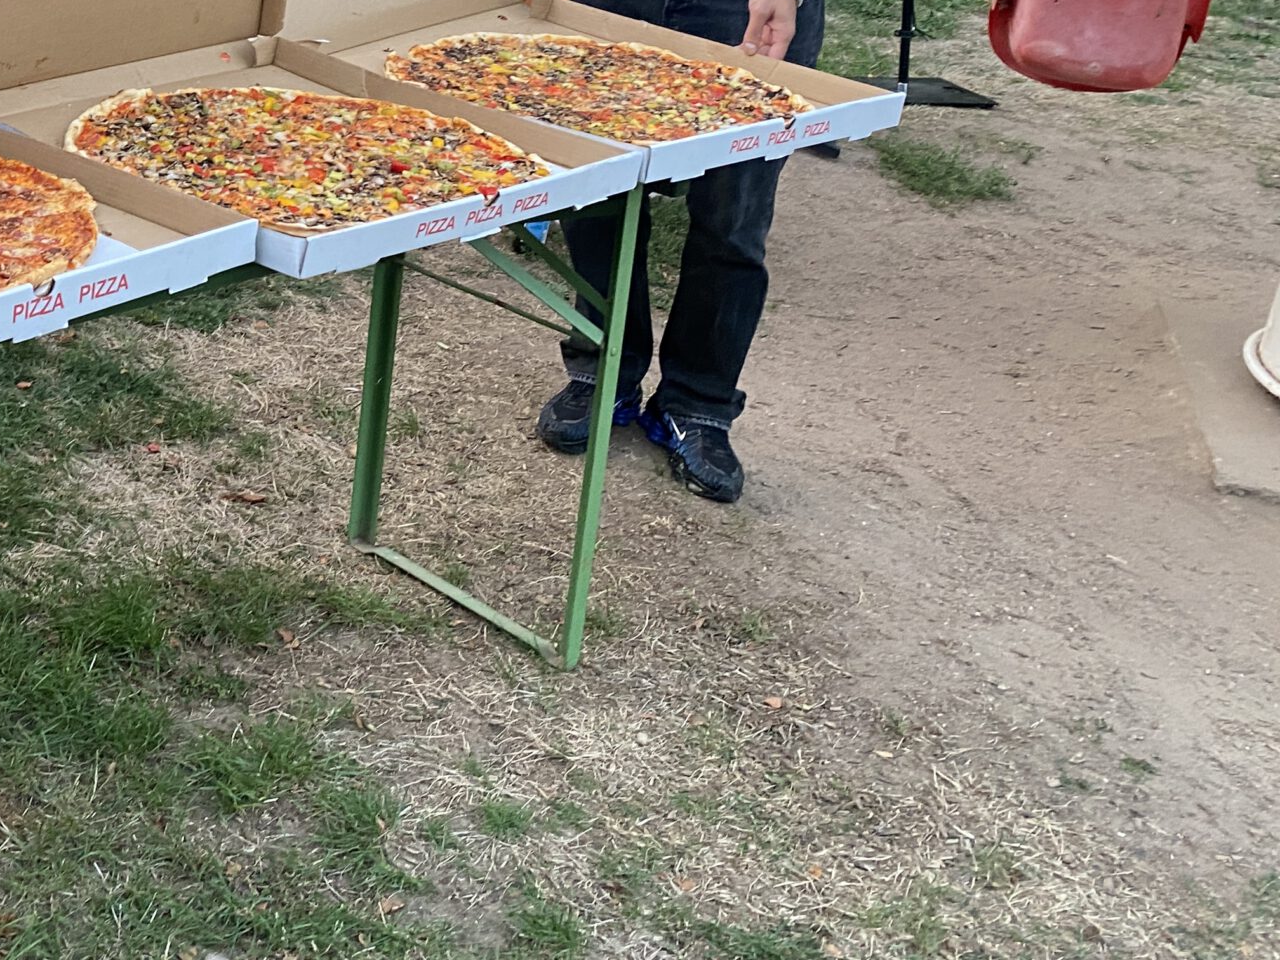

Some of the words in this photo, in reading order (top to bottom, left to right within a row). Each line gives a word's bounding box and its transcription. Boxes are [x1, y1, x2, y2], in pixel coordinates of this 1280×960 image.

[729, 136, 759, 154] PIZZA
[767, 128, 796, 146] PIZZA
[802, 120, 831, 138] PIZZA
[416, 215, 456, 238] PIZZA
[465, 204, 503, 226] PIZZA
[512, 192, 549, 214] PIZZA
[12, 292, 65, 323] PIZZA
[79, 274, 129, 303] PIZZA
